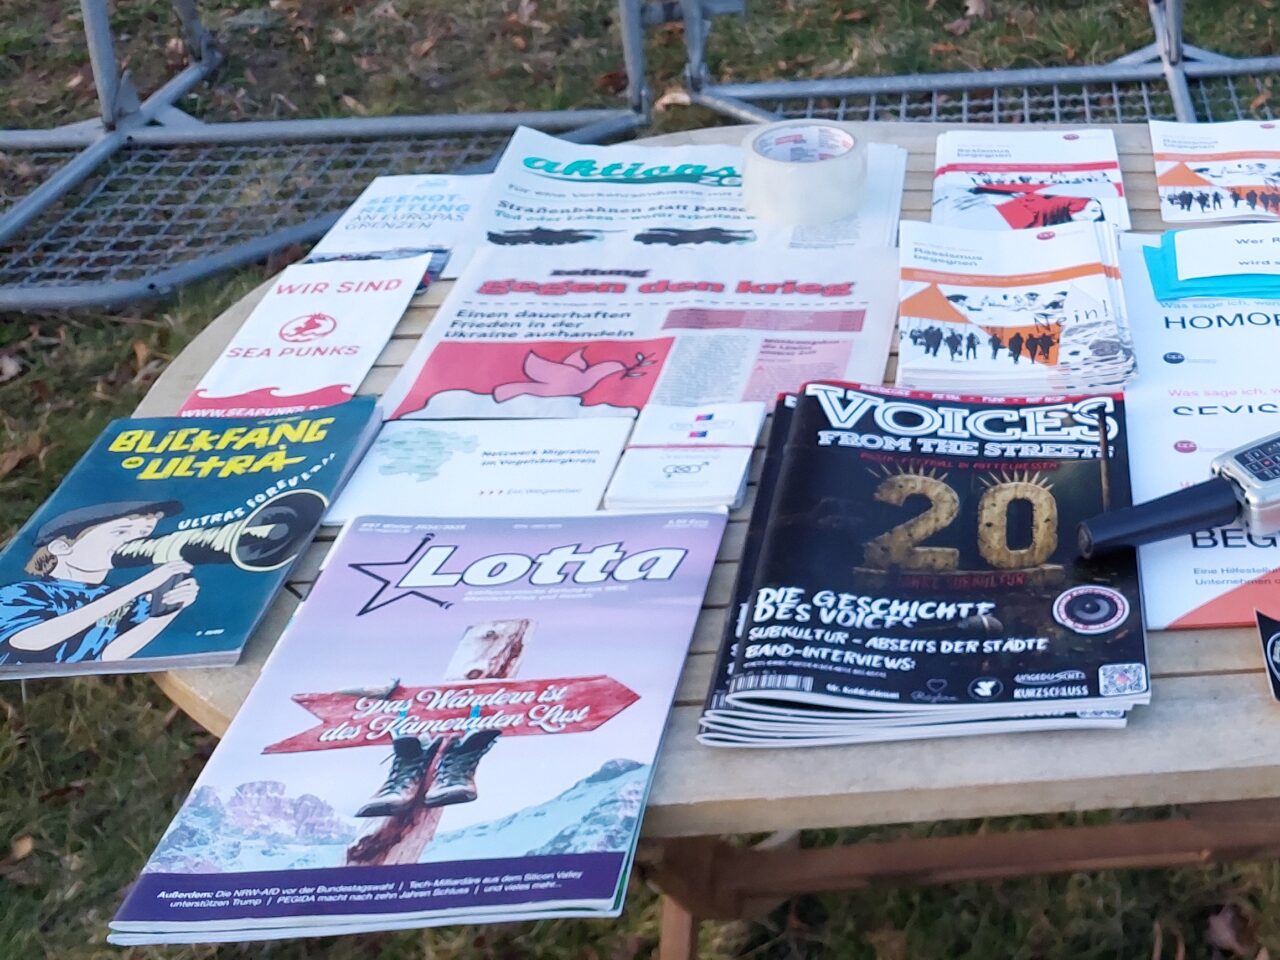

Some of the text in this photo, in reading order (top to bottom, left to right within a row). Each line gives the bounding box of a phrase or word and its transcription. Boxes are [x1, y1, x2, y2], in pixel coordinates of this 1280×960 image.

[359, 203, 472, 214] RETTUNG
[1236, 237, 1265, 245] Wer
[1237, 258, 1271, 266] wird
[275, 278, 402, 295] WIR SIND
[476, 278, 856, 298] gegen den krieg
[449, 319, 584, 329] Frieden in der
[456, 309, 632, 319] Einen dauerhaften
[1033, 299, 1111, 334] Nein!
[444, 329, 635, 339] Ukraine aushandeln
[226, 345, 361, 358] SEA PUNKS
[1168, 389, 1200, 398] Was
[1202, 389, 1238, 398] sage
[805, 383, 1119, 441] VOICES
[817, 430, 1115, 459] FROM THE STREETS
[177, 506, 246, 530] ULTRAS
[862, 472, 1059, 571] 20
[396, 541, 689, 589] Lotta
[1193, 567, 1218, 575] Eine
[1194, 577, 1272, 586] Unternehmen
[753, 603, 812, 623] DES
[757, 586, 997, 621] DIE GESCHICHTE
[748, 625, 1051, 654] SUBKULTUR ABSEITS DER STÄDTE
[416, 688, 534, 711] Wandern
[538, 685, 567, 703] ist
[322, 703, 592, 742] des Kameraden Lust
[157, 889, 213, 899] Außerdem:
[214, 890, 233, 899] Die
[233, 887, 281, 897] NRW-AfD
[298, 886, 315, 895] der
[316, 881, 394, 894] Bundestagswahl
[409, 877, 481, 889] Tech-Milliardäre
[500, 874, 523, 884] dem
[523, 873, 554, 882] Silicon
[555, 870, 584, 881] Valley
[169, 899, 230, 908] unterstützen
[231, 897, 262, 907] Trump
[276, 895, 317, 904] PEGIDA
[317, 894, 348, 902] macht
[349, 893, 373, 901] nach
[374, 892, 398, 901] zehn
[398, 889, 432, 900] Jahren
[432, 887, 470, 897] Schluss
[483, 884, 503, 892] und
[503, 882, 531, 891] vieles
